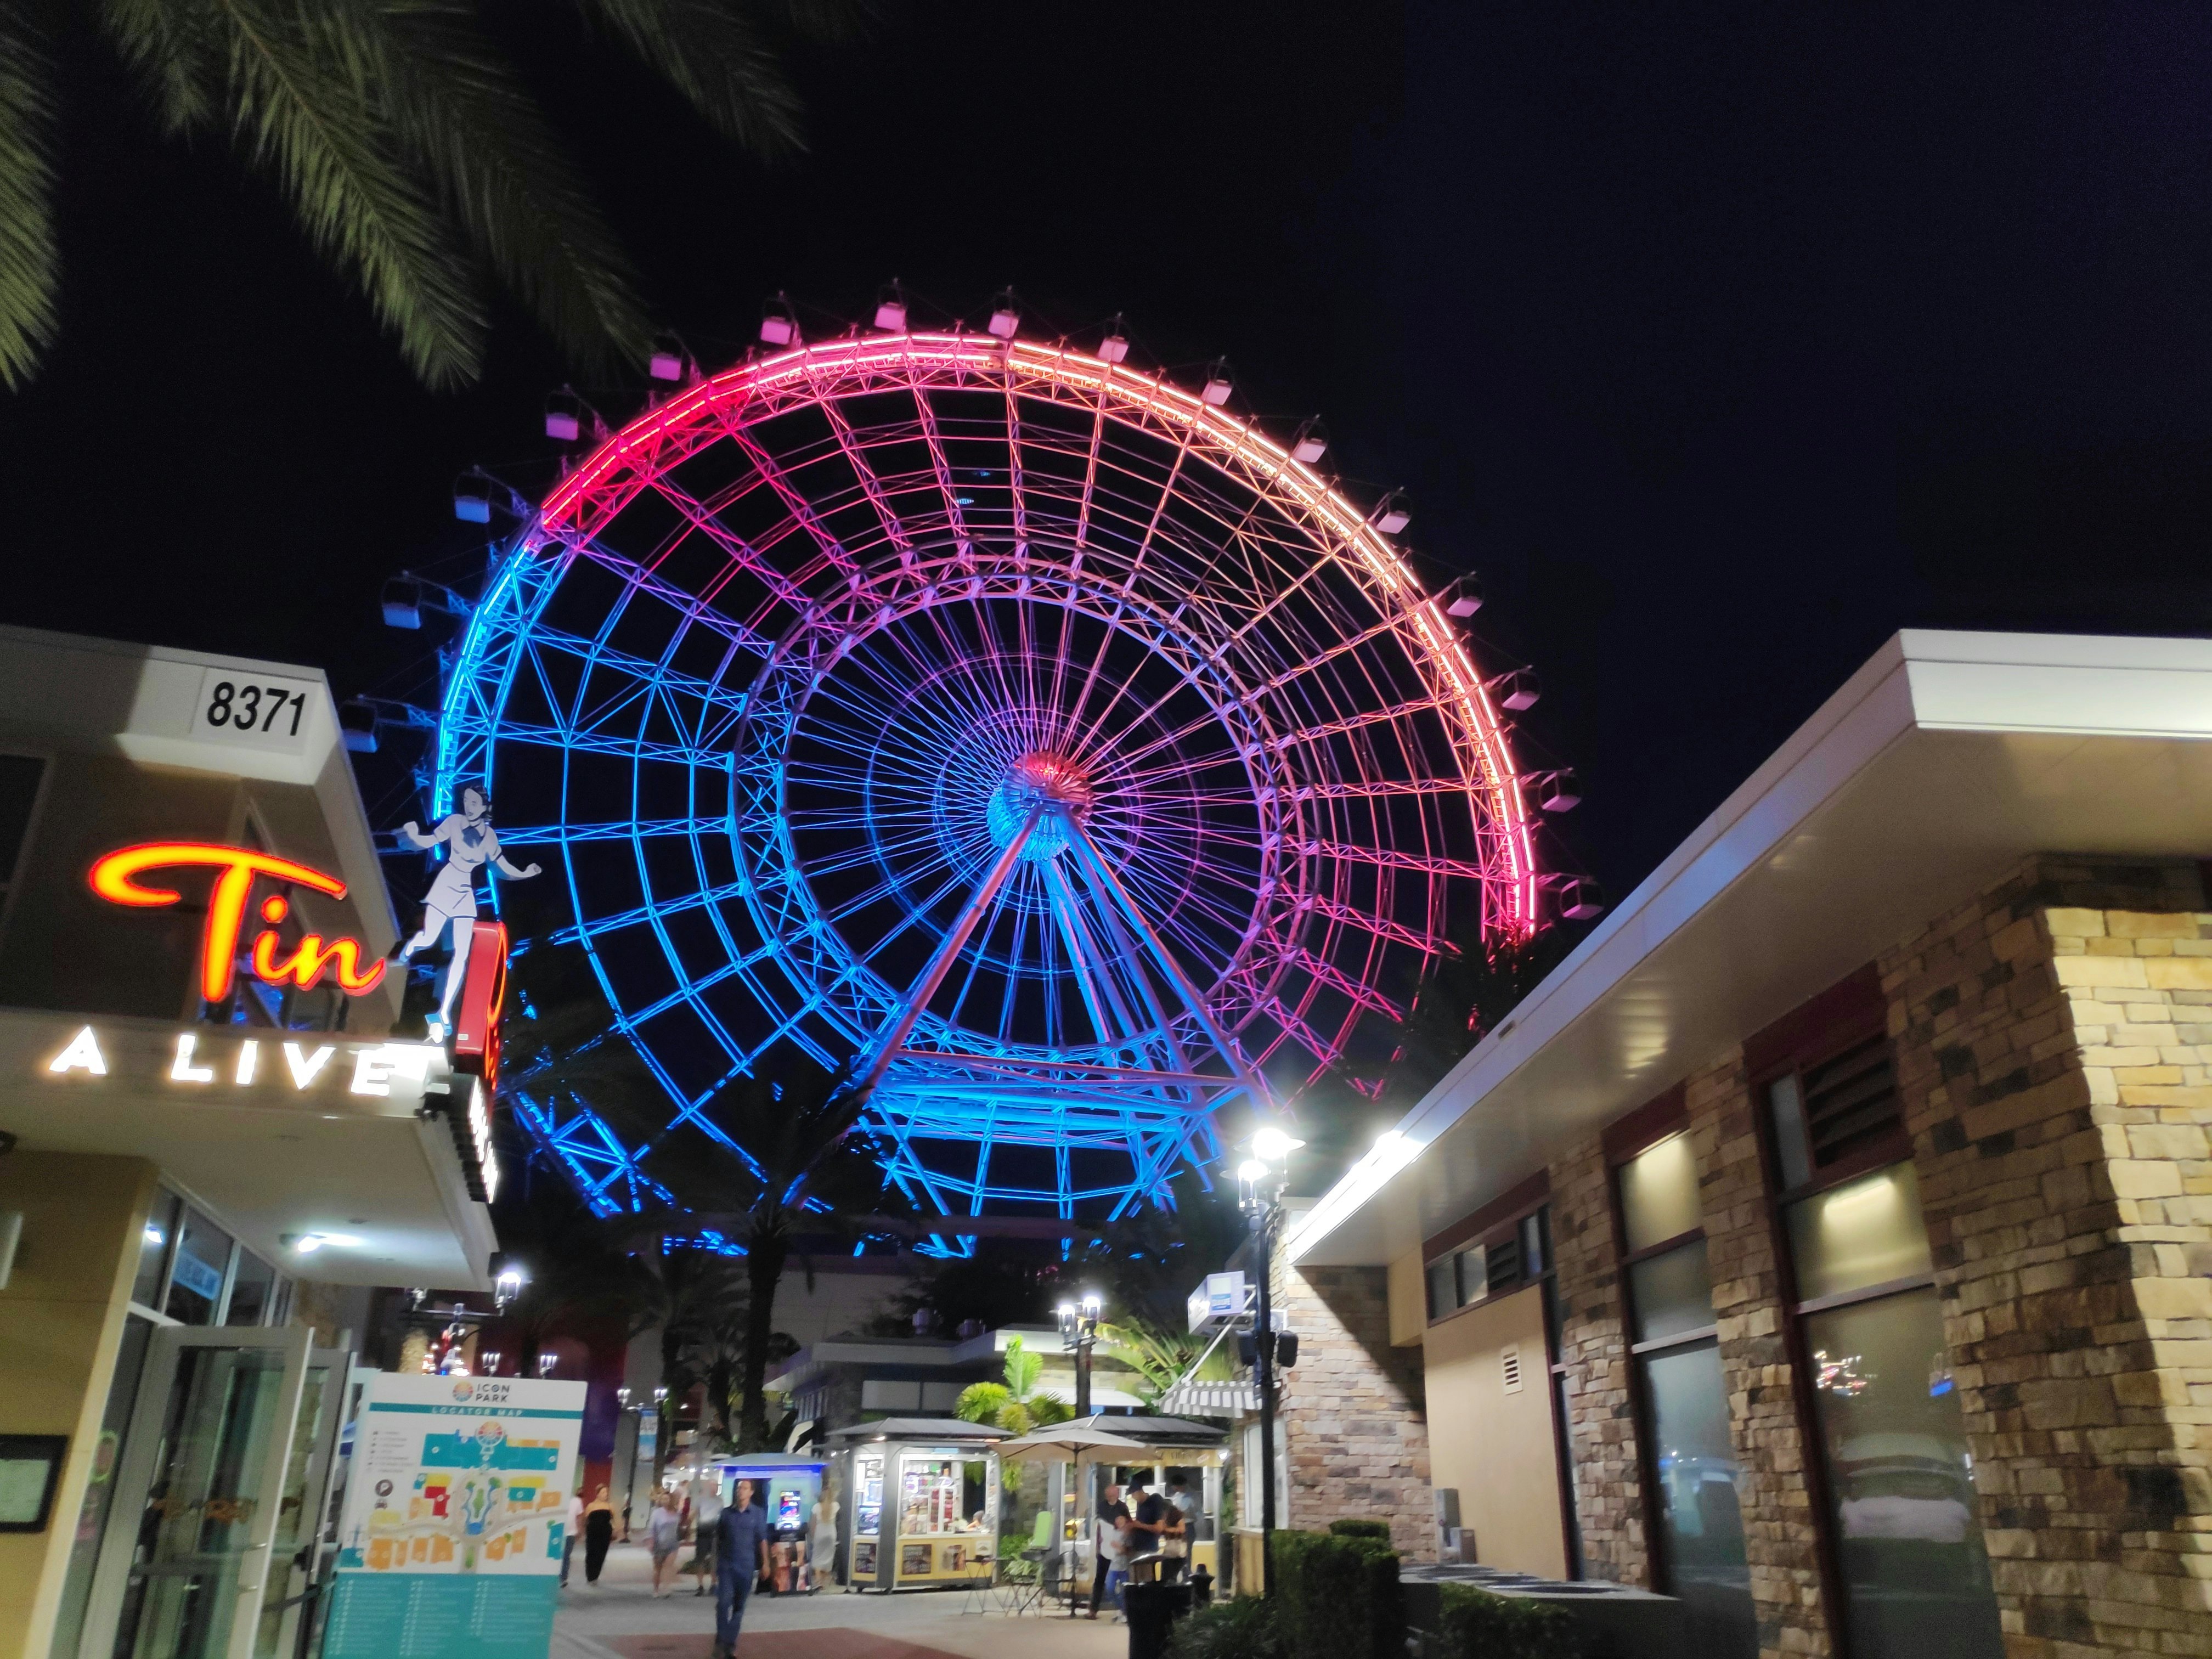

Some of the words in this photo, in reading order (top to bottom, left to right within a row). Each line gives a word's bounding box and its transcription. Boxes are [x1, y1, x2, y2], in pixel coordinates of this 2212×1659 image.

[207, 681, 306, 736] 8371
[89, 842, 387, 1002] Tin
[48, 1025, 108, 1075] A
[170, 1034, 391, 1096] LIVE
[475, 1393, 509, 1403] PARK
[477, 1384, 510, 1393] ICON
[432, 1406, 490, 1416] LOCATOR
